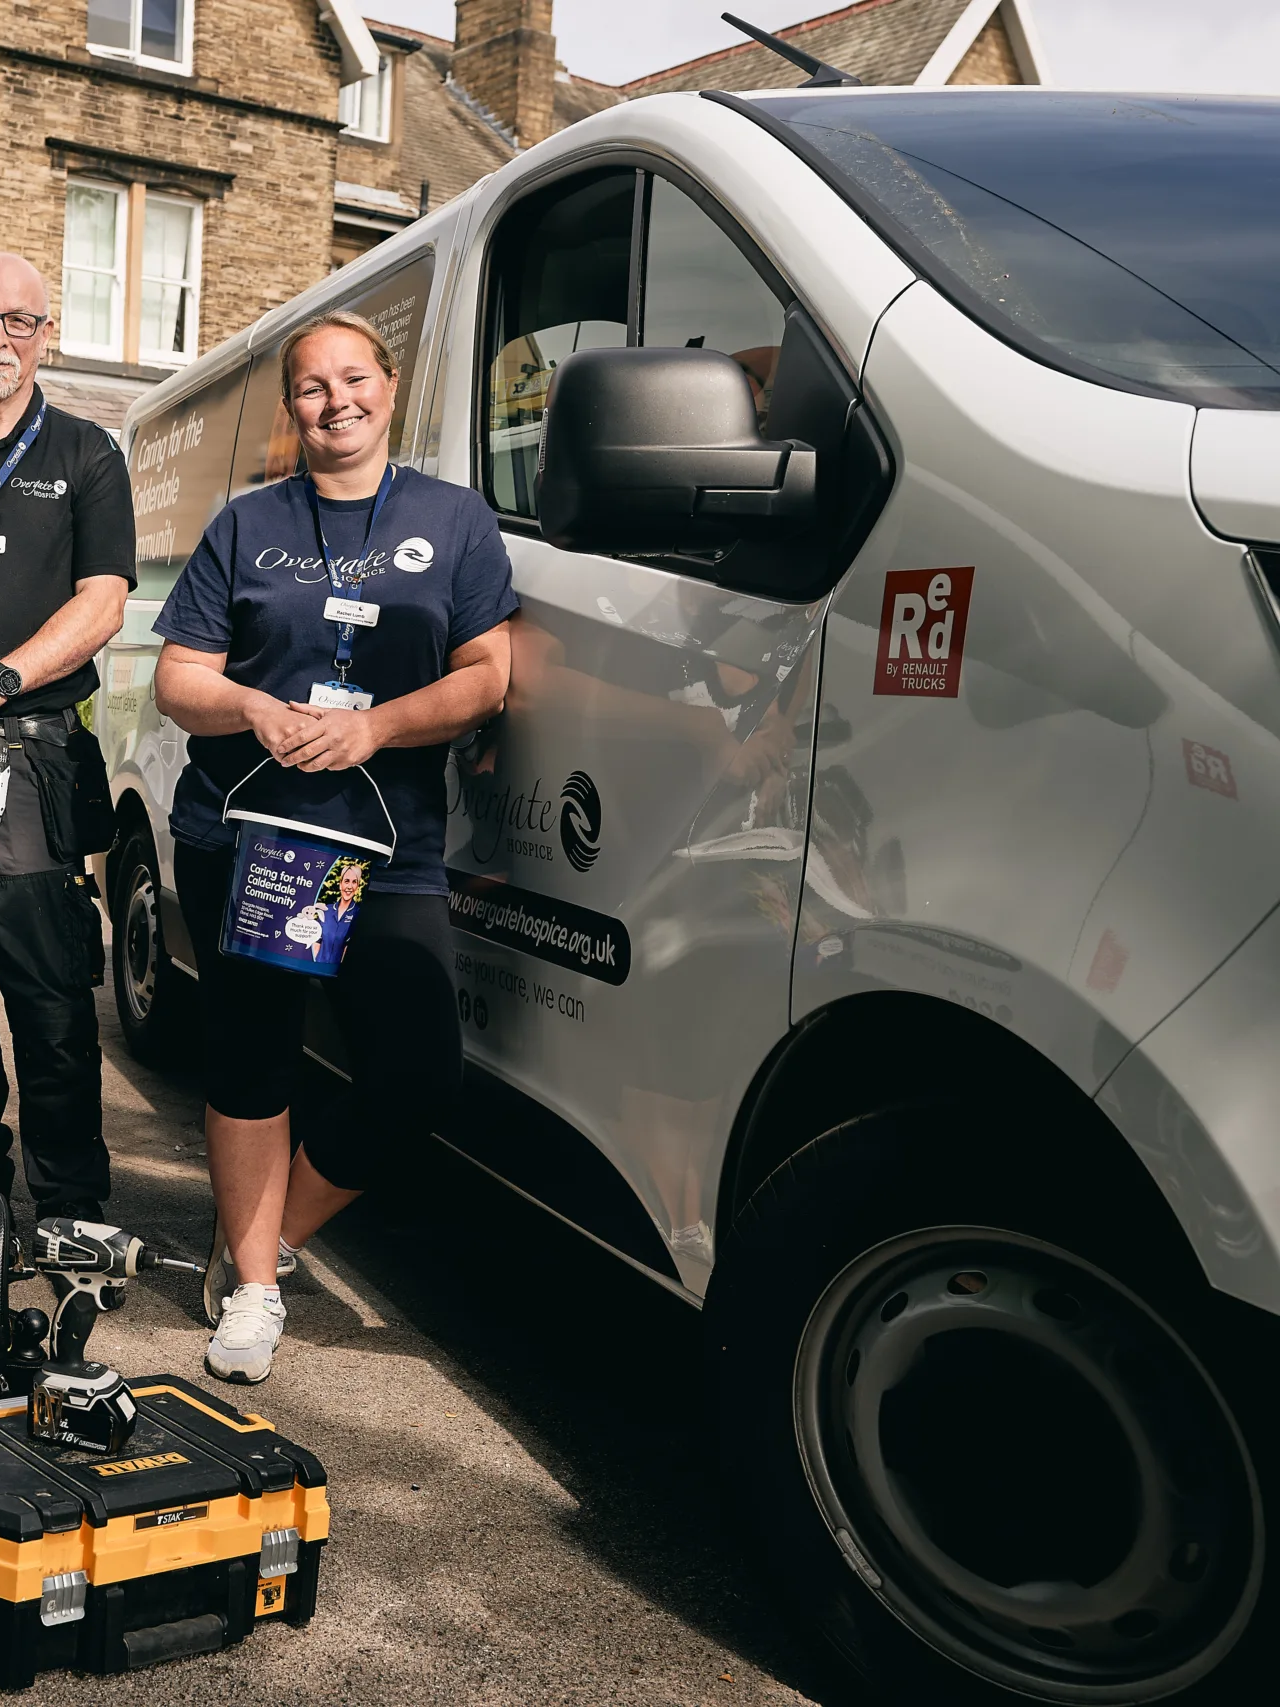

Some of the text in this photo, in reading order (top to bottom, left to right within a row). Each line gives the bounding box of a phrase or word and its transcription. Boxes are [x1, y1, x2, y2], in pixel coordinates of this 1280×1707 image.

[400, 296, 416, 312] been
[137, 411, 204, 472] Caring for the
[11, 478, 54, 495] Overgate
[34, 491, 59, 499] HOSPICE
[133, 467, 180, 517] Calderdale
[136, 519, 176, 566] mmunity
[886, 663, 948, 677] By RENAULT
[901, 677, 946, 690] TRUCKS
[318, 696, 353, 709] Overgate
[254, 842, 284, 859] Overgate
[507, 838, 554, 862] HOSPICE
[247, 874, 296, 896] Calderdale
[250, 863, 313, 888] Caring for the
[245, 885, 297, 910] Community
[448, 891, 616, 966] w.overgatehospice.org.uk
[474, 958, 495, 985] you
[498, 968, 530, 1003] care,
[533, 982, 555, 1010] we
[558, 992, 585, 1023] can
[89, 1452, 191, 1477] DEWALT
